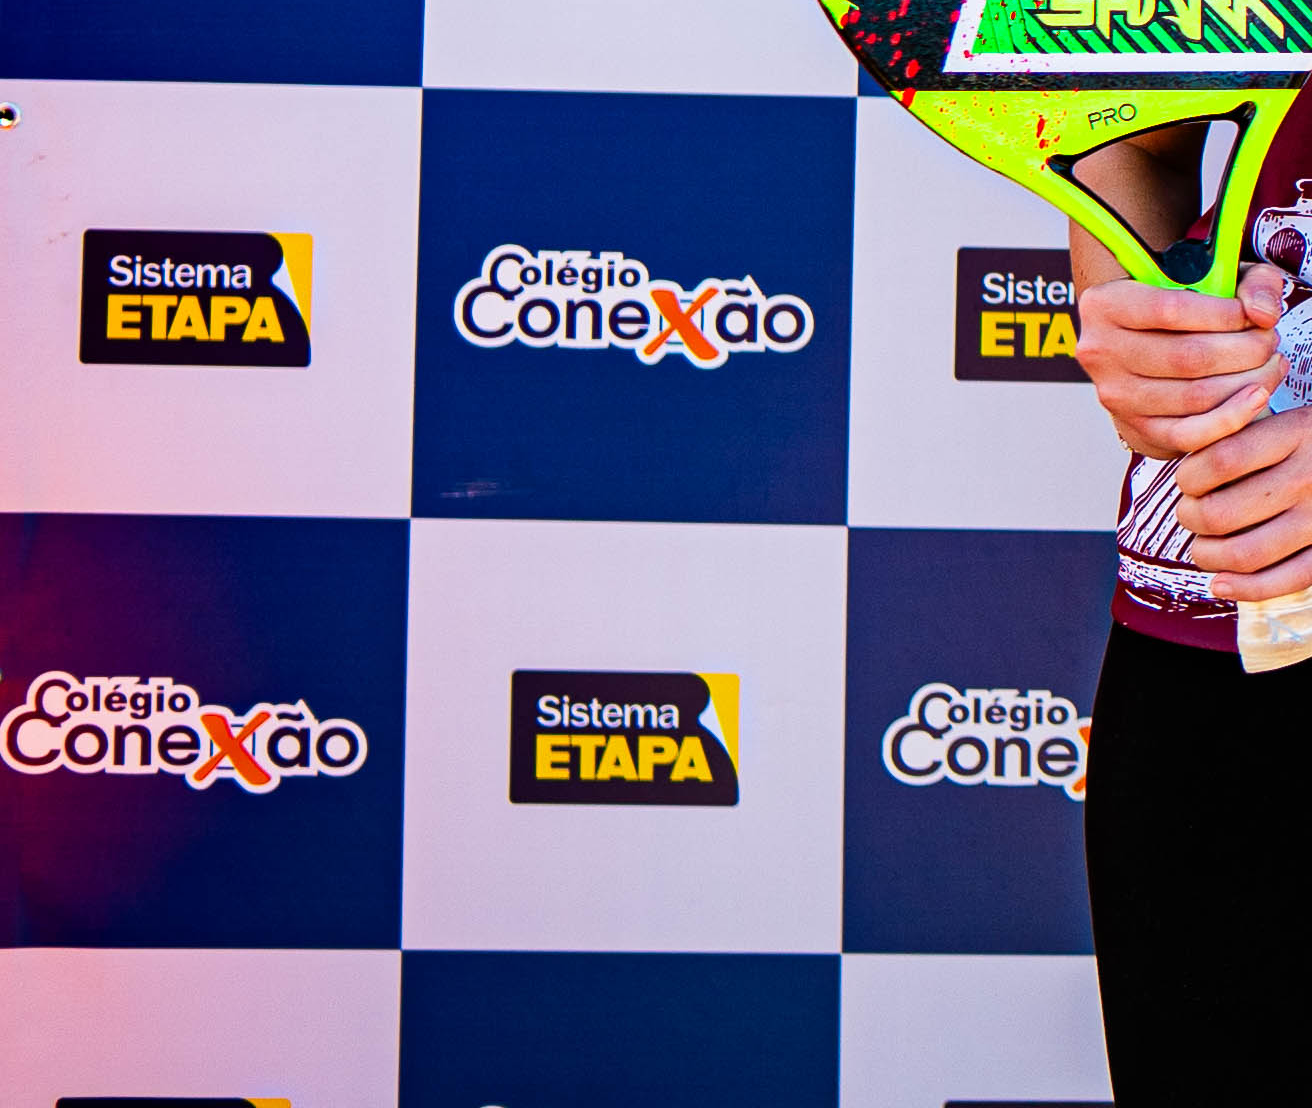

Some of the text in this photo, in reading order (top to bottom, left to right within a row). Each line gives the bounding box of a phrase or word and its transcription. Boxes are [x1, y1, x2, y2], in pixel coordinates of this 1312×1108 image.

[1086, 102, 1138, 131] PRO
[109, 256, 251, 288] Sistema
[488, 253, 640, 296] Colégio
[982, 273, 1075, 304] Siste
[106, 295, 284, 341] ETAPA
[981, 312, 1078, 358] ETA
[36, 680, 191, 722] Colégio
[537, 696, 679, 728] Sistema
[918, 692, 1069, 734] Colégio
[535, 735, 712, 781] ETAPA
[892, 722, 1089, 792] Cone
